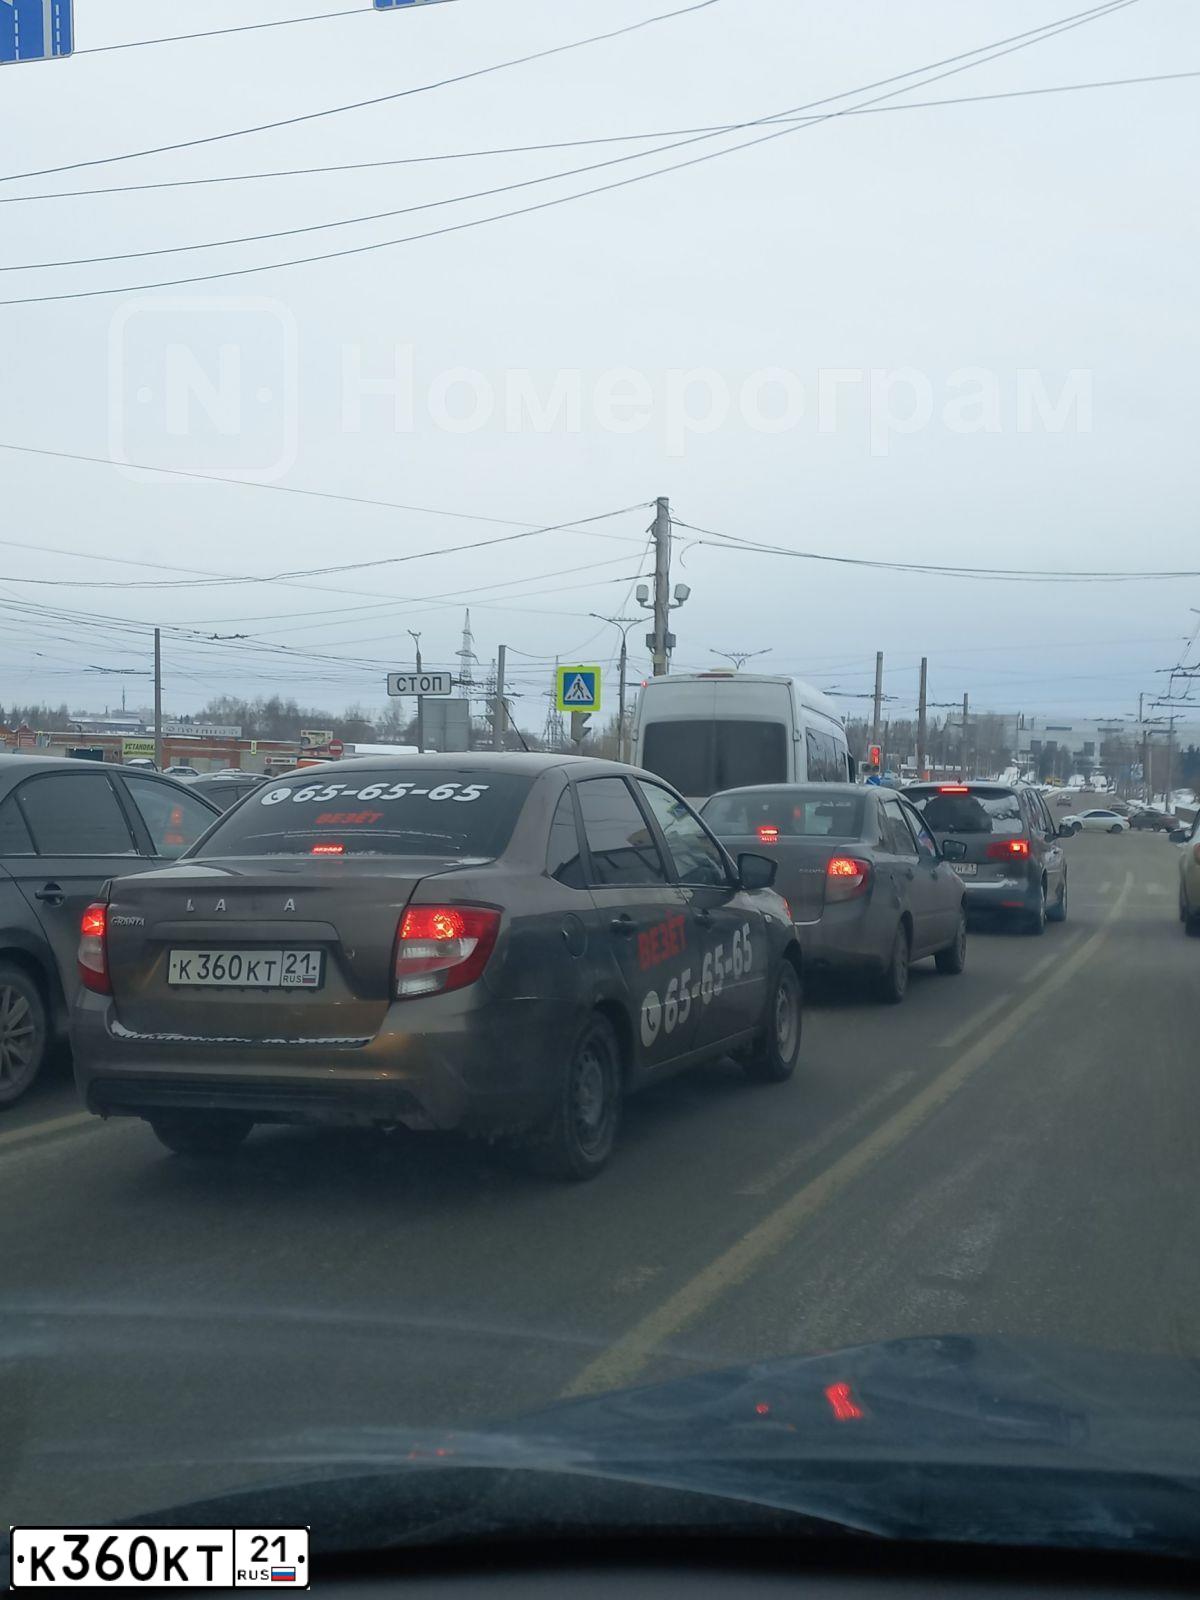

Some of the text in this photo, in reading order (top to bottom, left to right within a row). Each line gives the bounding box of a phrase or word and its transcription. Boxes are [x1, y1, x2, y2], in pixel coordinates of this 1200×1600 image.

[396, 676, 442, 692] СТОП
[124, 743, 155, 751] УСТАНОВК
[292, 782, 490, 802] 65-65-65
[110, 915, 145, 927] GRANTA
[178, 953, 310, 982] К360КТ 21
[282, 975, 302, 985] RUS
[664, 922, 752, 1034] 65-65-65
